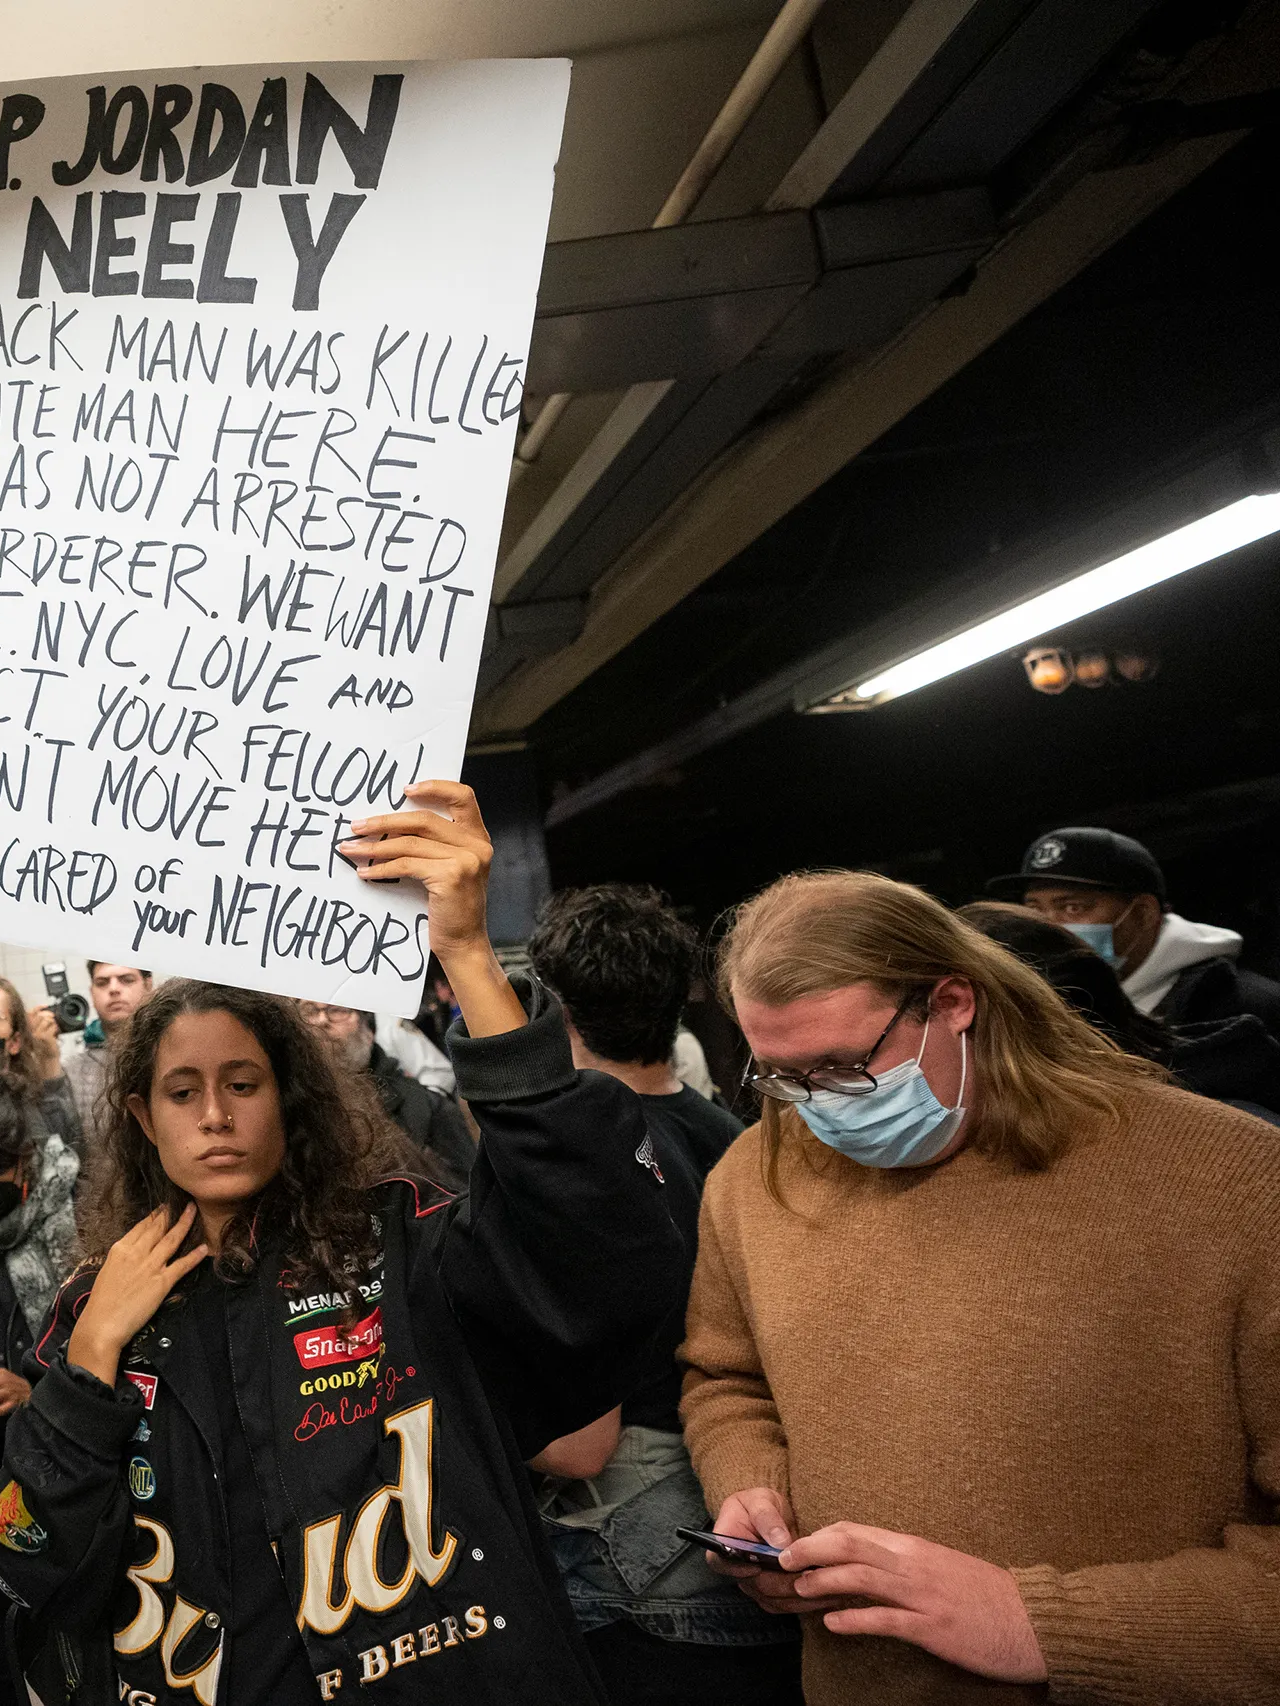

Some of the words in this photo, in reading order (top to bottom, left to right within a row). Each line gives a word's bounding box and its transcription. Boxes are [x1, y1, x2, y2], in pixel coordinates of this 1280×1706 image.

[52, 74, 405, 189] JORDAN
[17, 190, 367, 311] NEELY
[106, 315, 228, 384] MAN
[246, 328, 345, 394] WAS
[366, 324, 524, 435] KILLED
[73, 383, 188, 453] MAN
[212, 395, 435, 502] HERE.
[83, 453, 179, 521] NOT
[181, 467, 466, 584] ARRESTED
[238, 555, 335, 632] WE
[325, 576, 473, 662] WANT
[167, 626, 321, 713] LOVE
[328, 674, 414, 713] AND
[88, 684, 222, 780] YOUR
[240, 724, 424, 811] FELLOW
[92, 755, 236, 847] MOVE
[246, 798, 400, 883] HER
[132, 900, 198, 952] your
[205, 874, 430, 982] NEIGHBORS
[130, 1463, 152, 1493] RITZ
